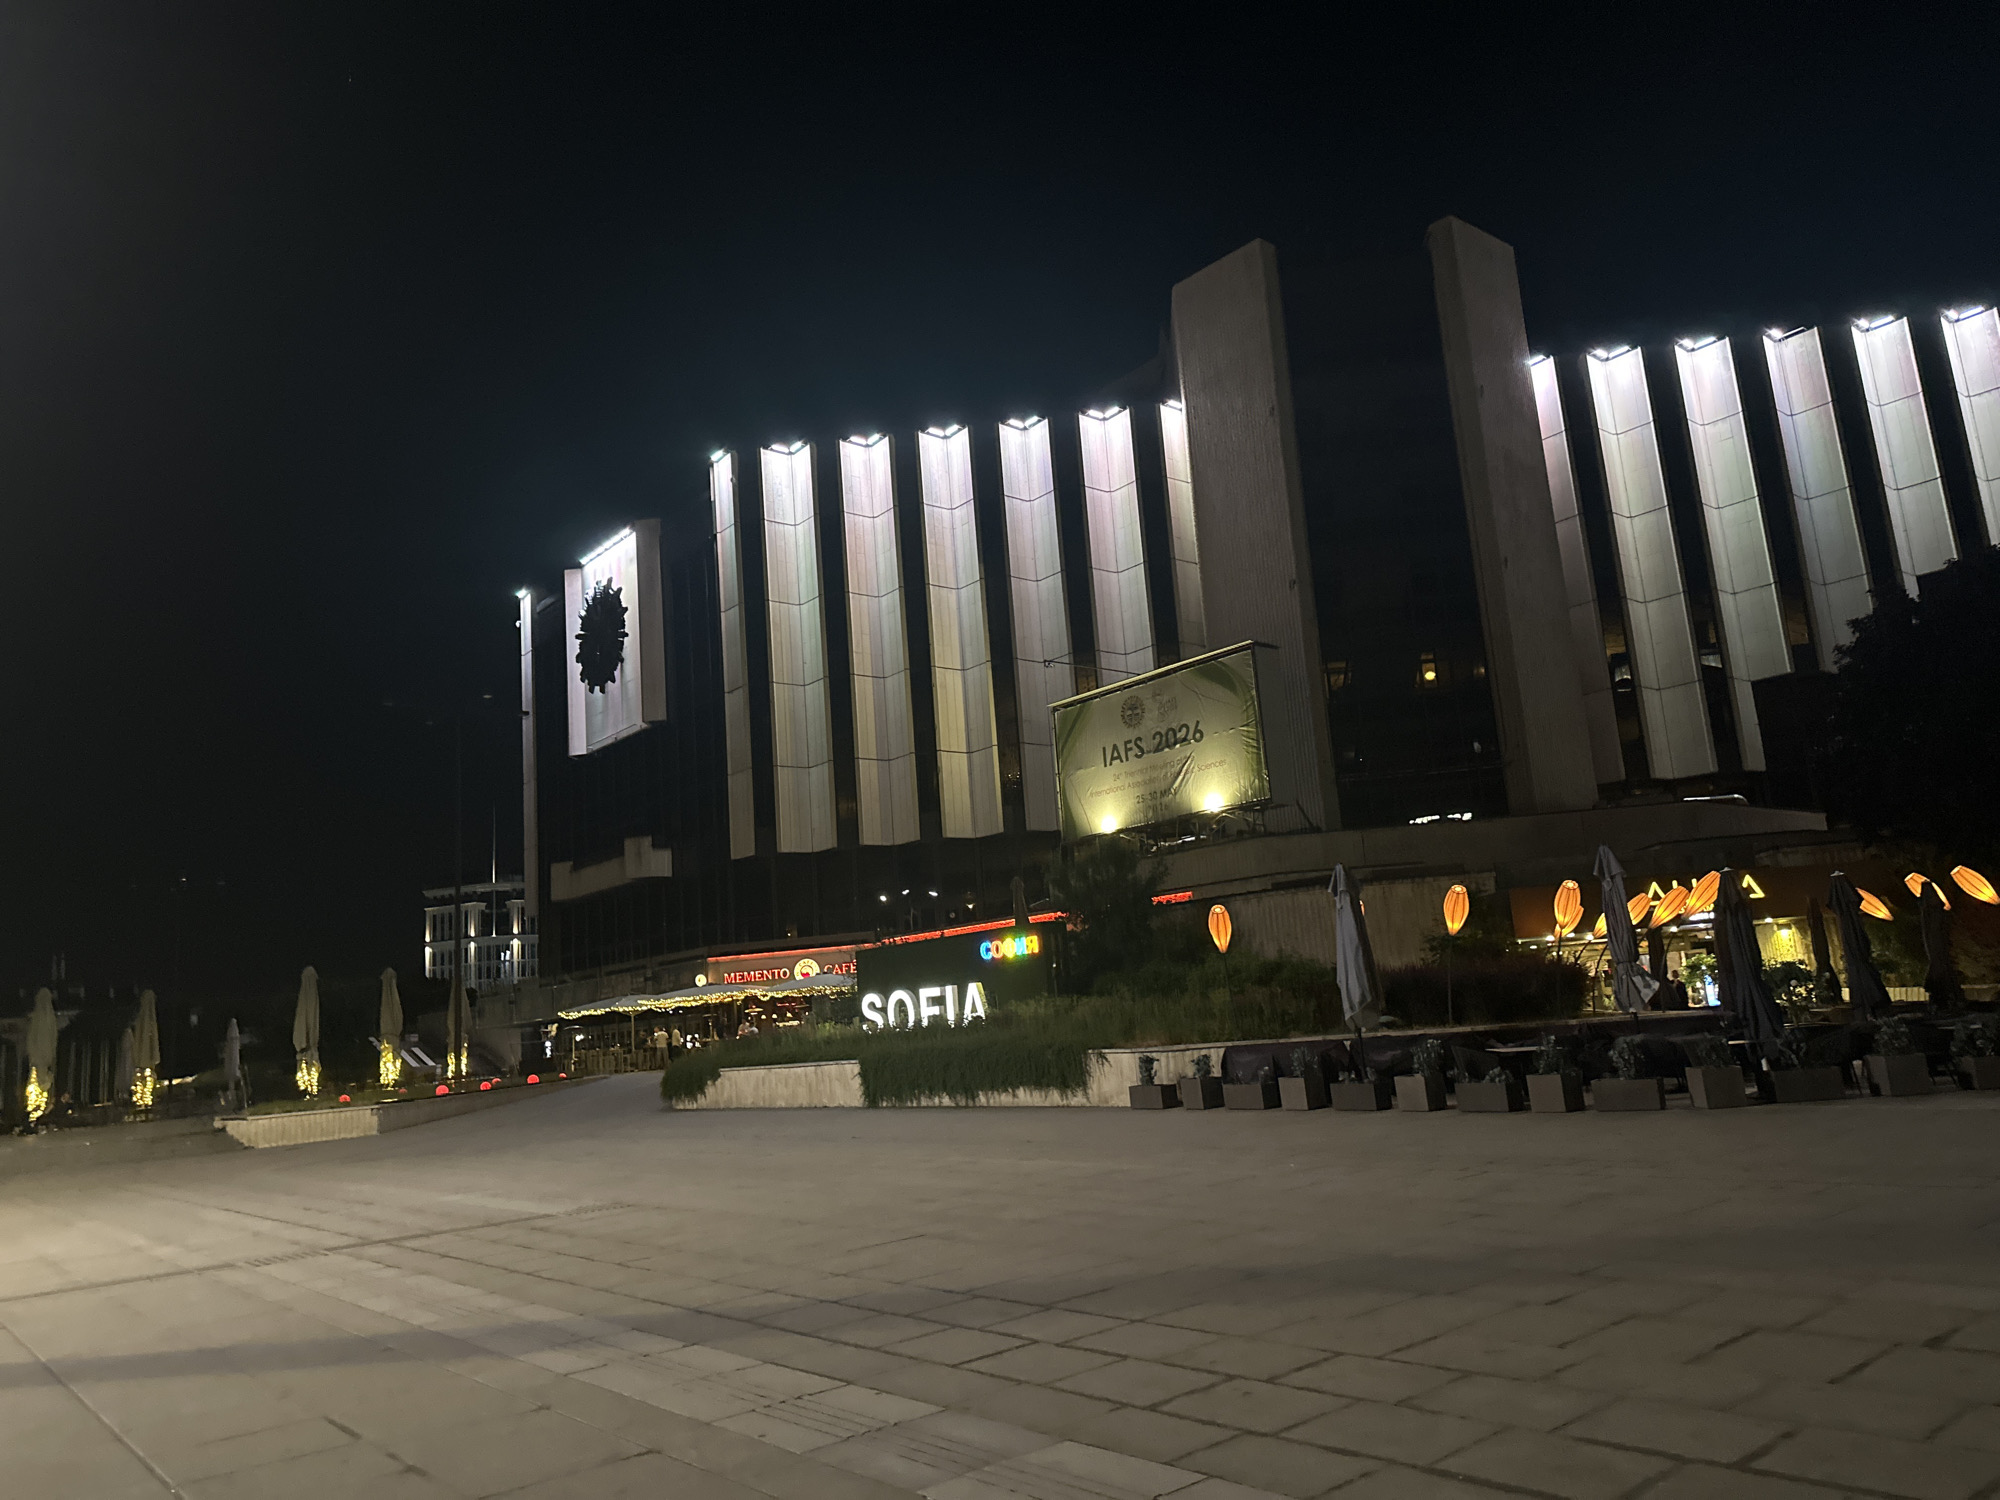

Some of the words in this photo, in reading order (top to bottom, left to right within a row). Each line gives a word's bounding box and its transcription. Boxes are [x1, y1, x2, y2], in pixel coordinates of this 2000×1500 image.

[1102, 736, 1146, 767] IAFS
[1152, 720, 1204, 754] 2026
[1135, 790, 1158, 804] 25-30
[980, 935, 1039, 960] СОФИЯ
[723, 967, 791, 984] MEMENTO
[823, 959, 857, 975] CAFÉ
[861, 981, 987, 1034] SOFIA
